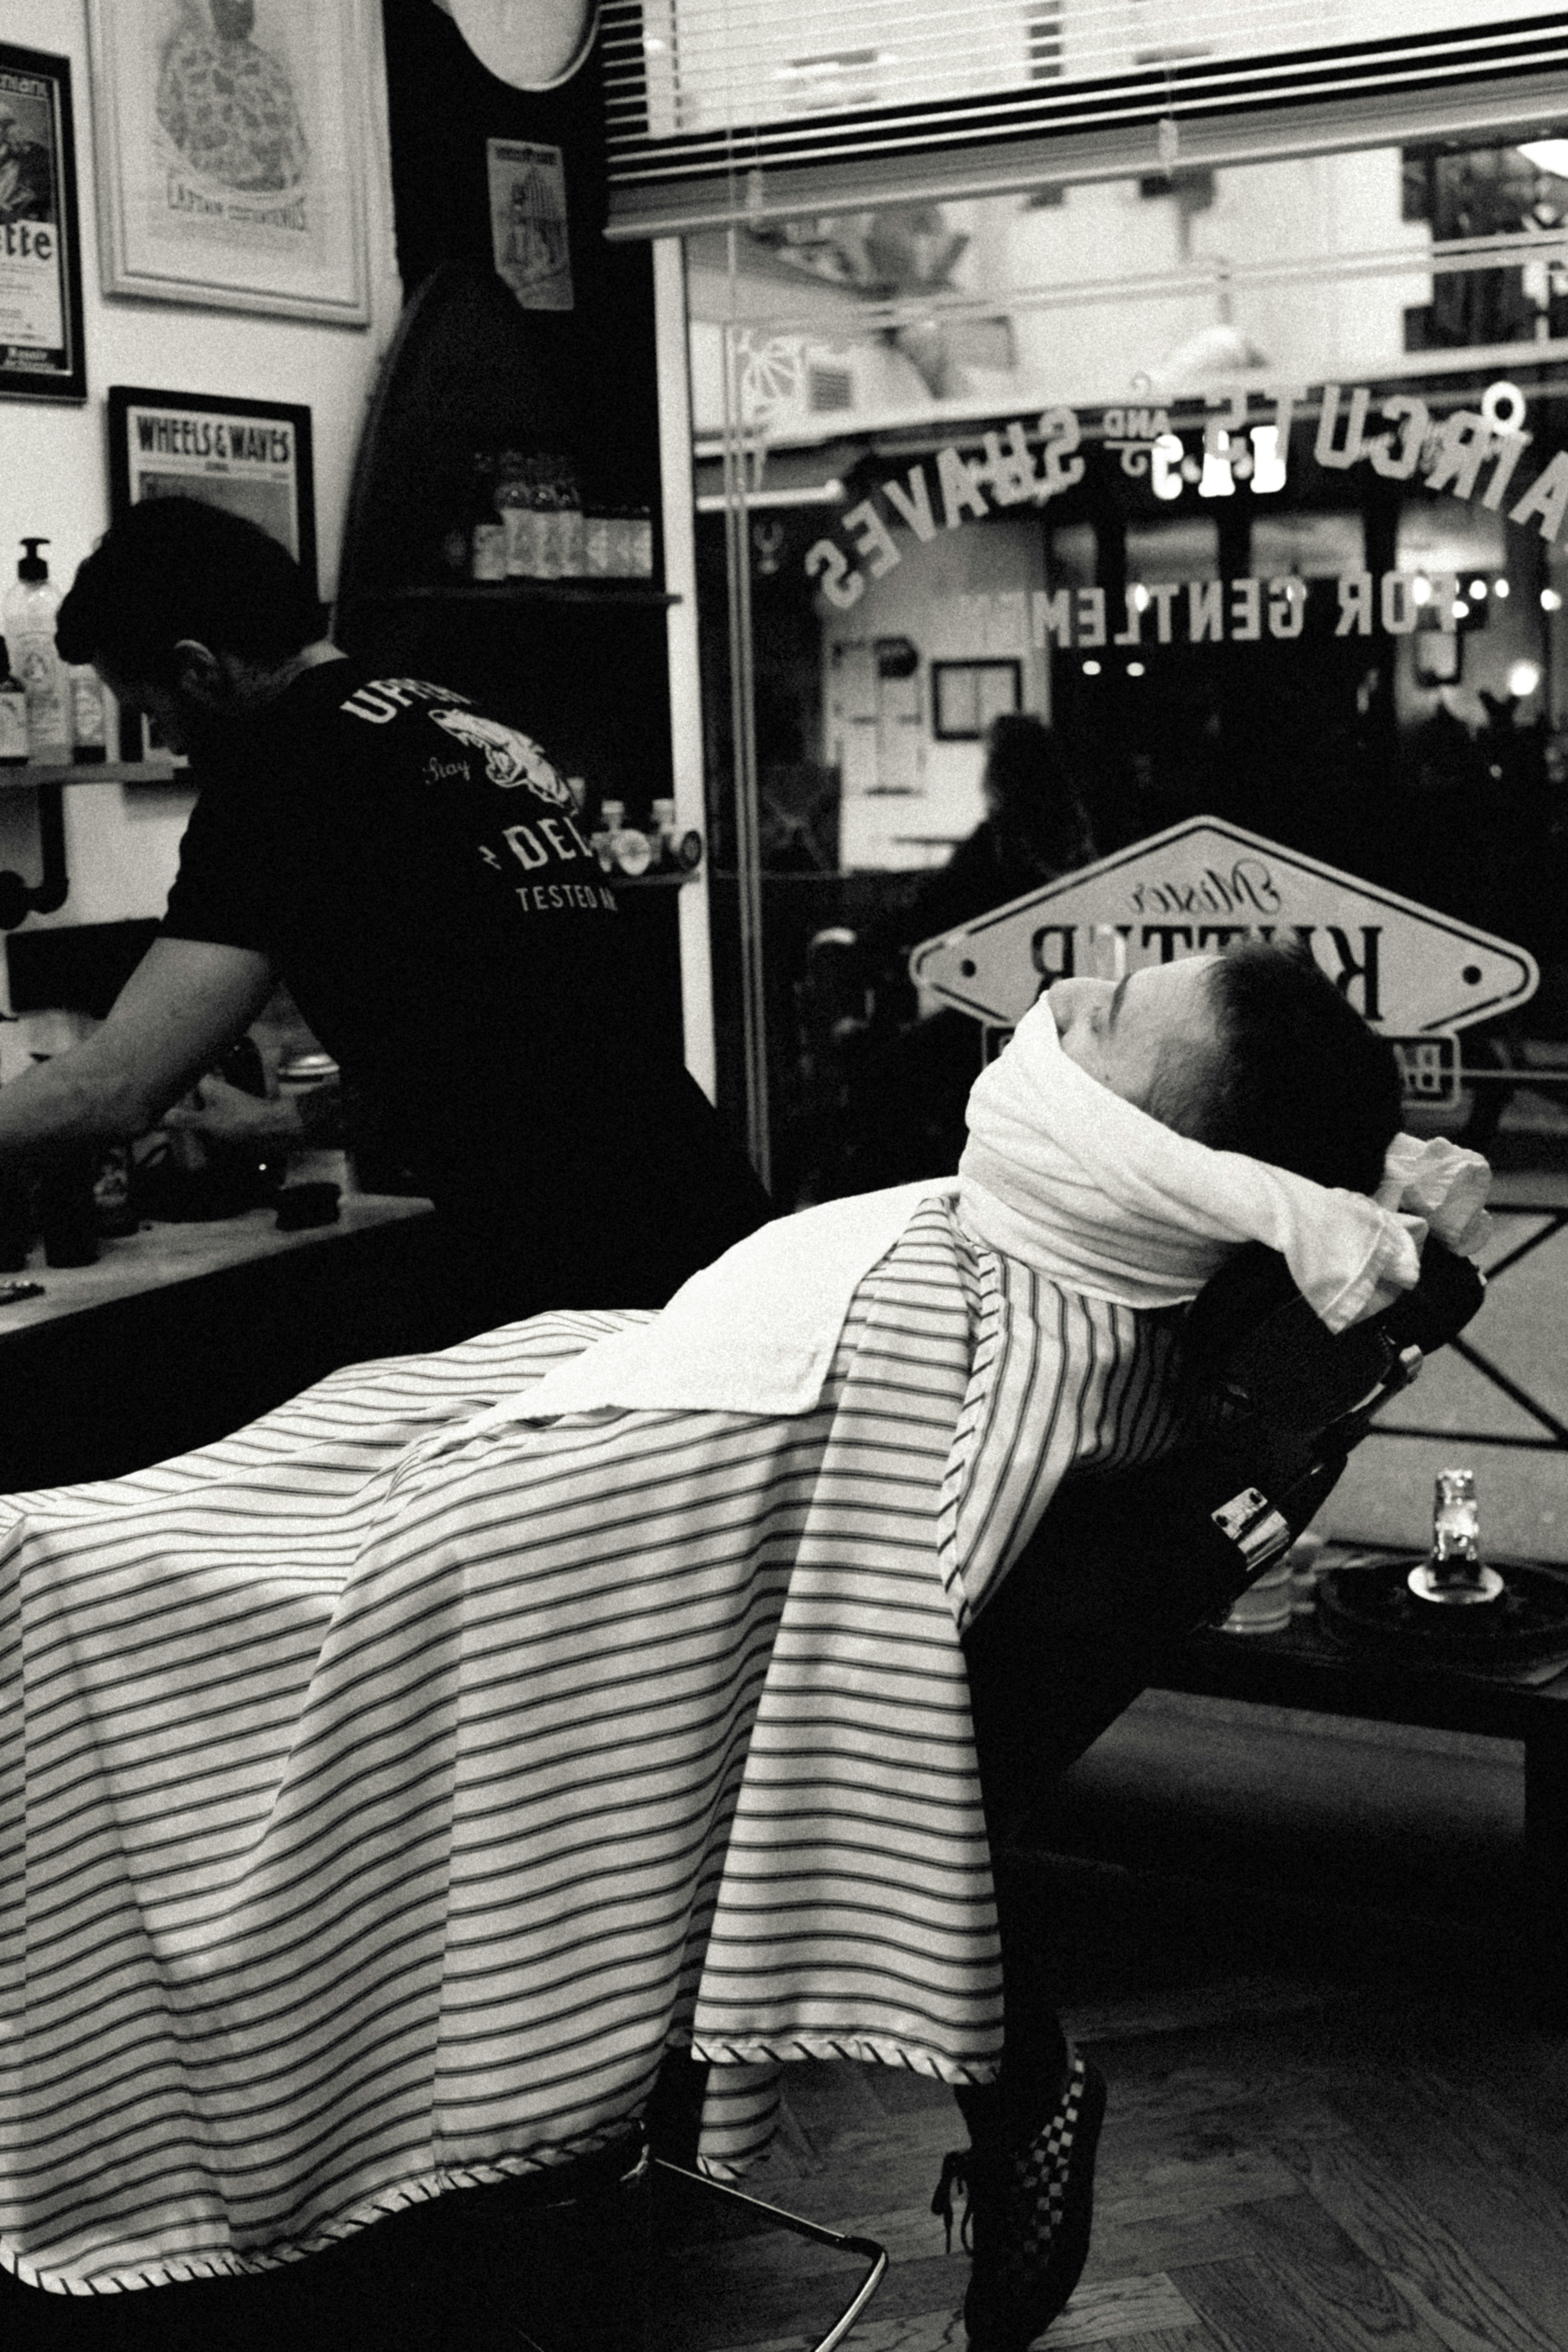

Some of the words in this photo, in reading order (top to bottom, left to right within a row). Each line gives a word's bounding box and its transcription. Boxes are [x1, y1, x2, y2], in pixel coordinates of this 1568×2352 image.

[0, 224, 52, 260] tte
[137, 415, 210, 456] WHEELS
[228, 424, 289, 463] WAVES
[515, 884, 597, 912] TESTED
